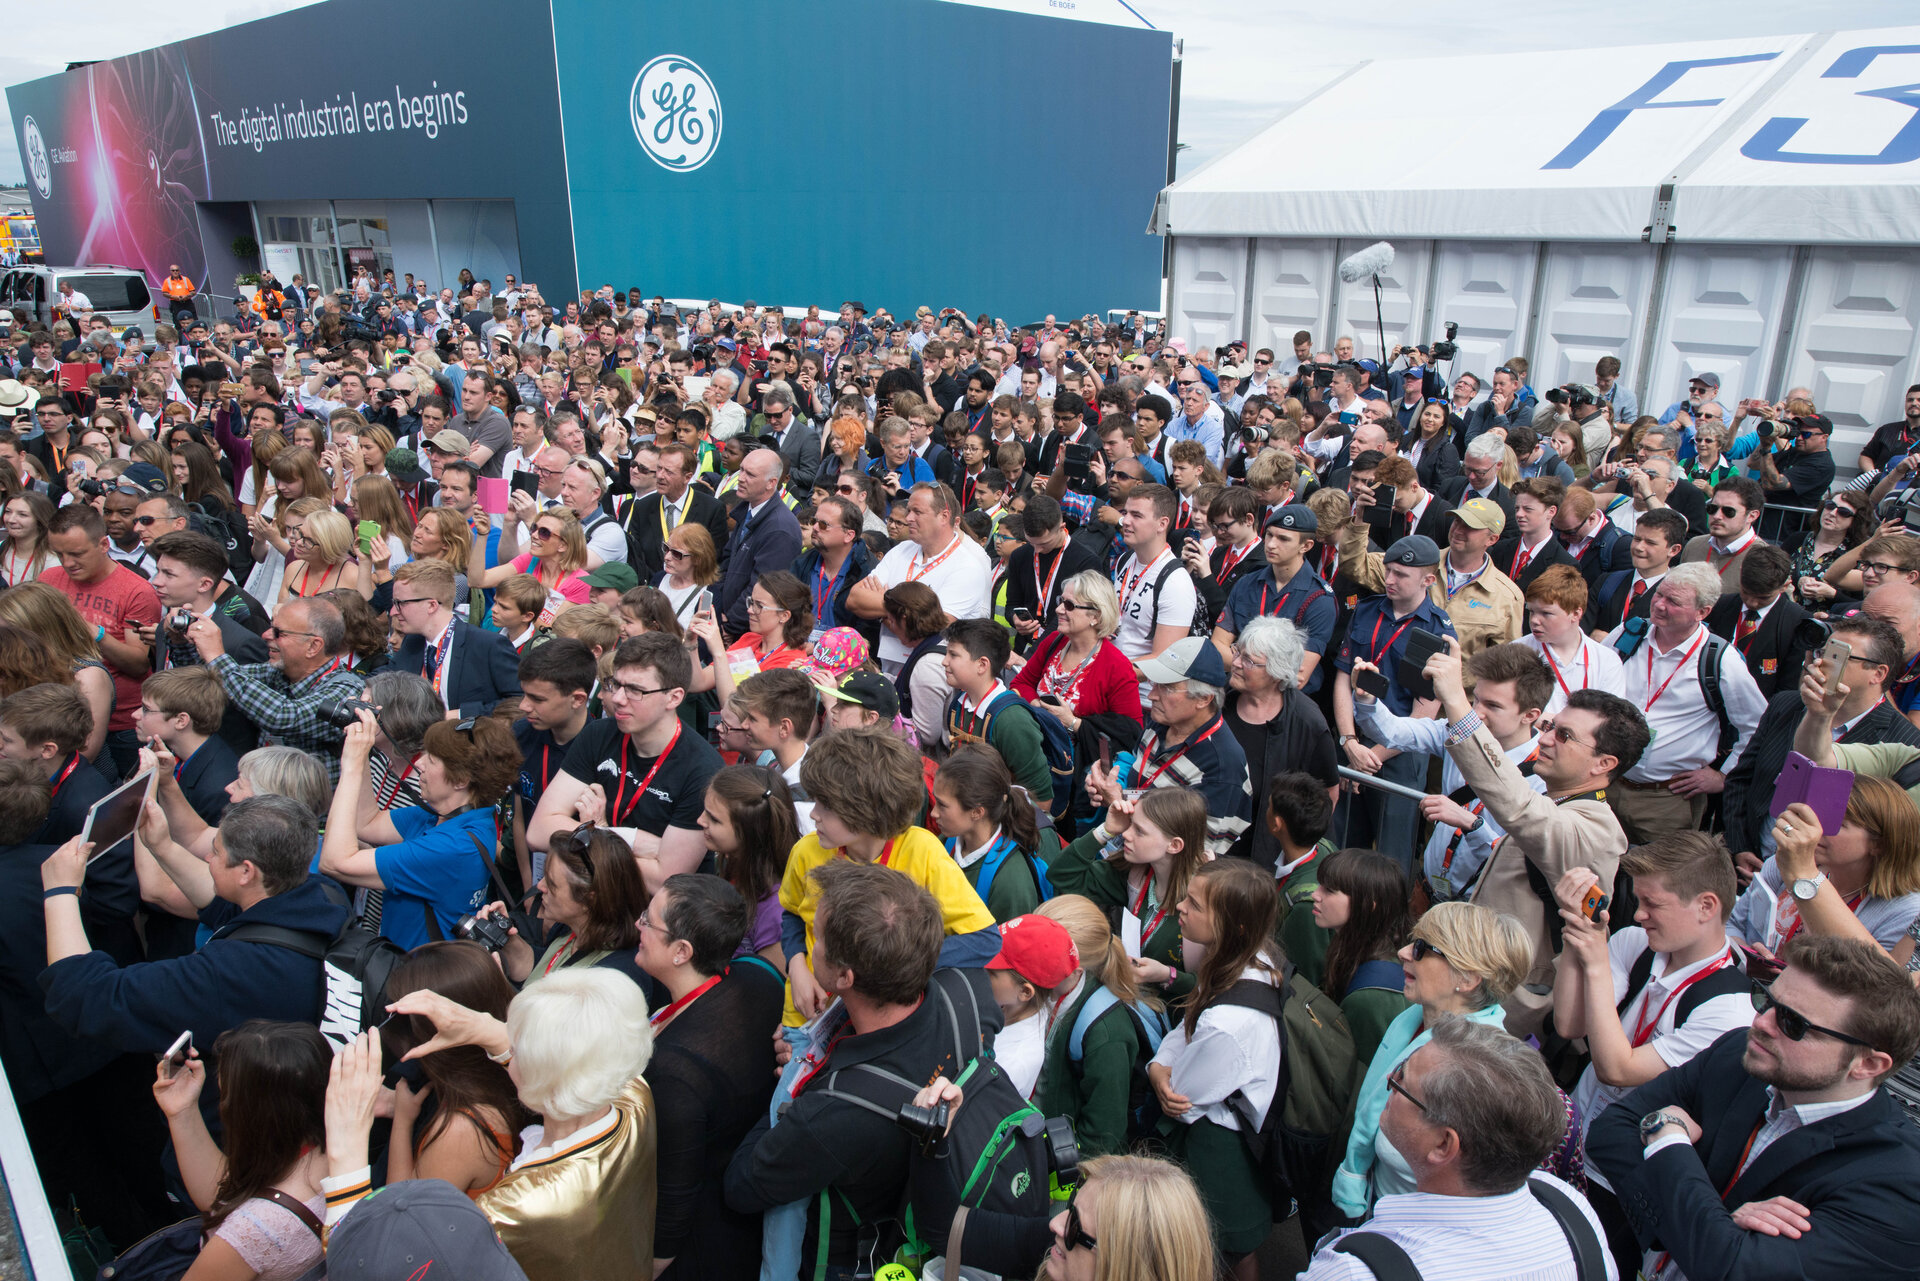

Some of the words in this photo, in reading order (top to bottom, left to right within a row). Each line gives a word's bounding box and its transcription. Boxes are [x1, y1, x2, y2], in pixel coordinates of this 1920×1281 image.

[211, 111, 238, 146] The
[240, 103, 283, 153] digital
[282, 91, 361, 139] industrial
[363, 99, 395, 133] era
[395, 80, 469, 139] begins
[51, 148, 60, 164] GE
[58, 146, 78, 163] Aviation
[319, 960, 362, 1055] NIK
